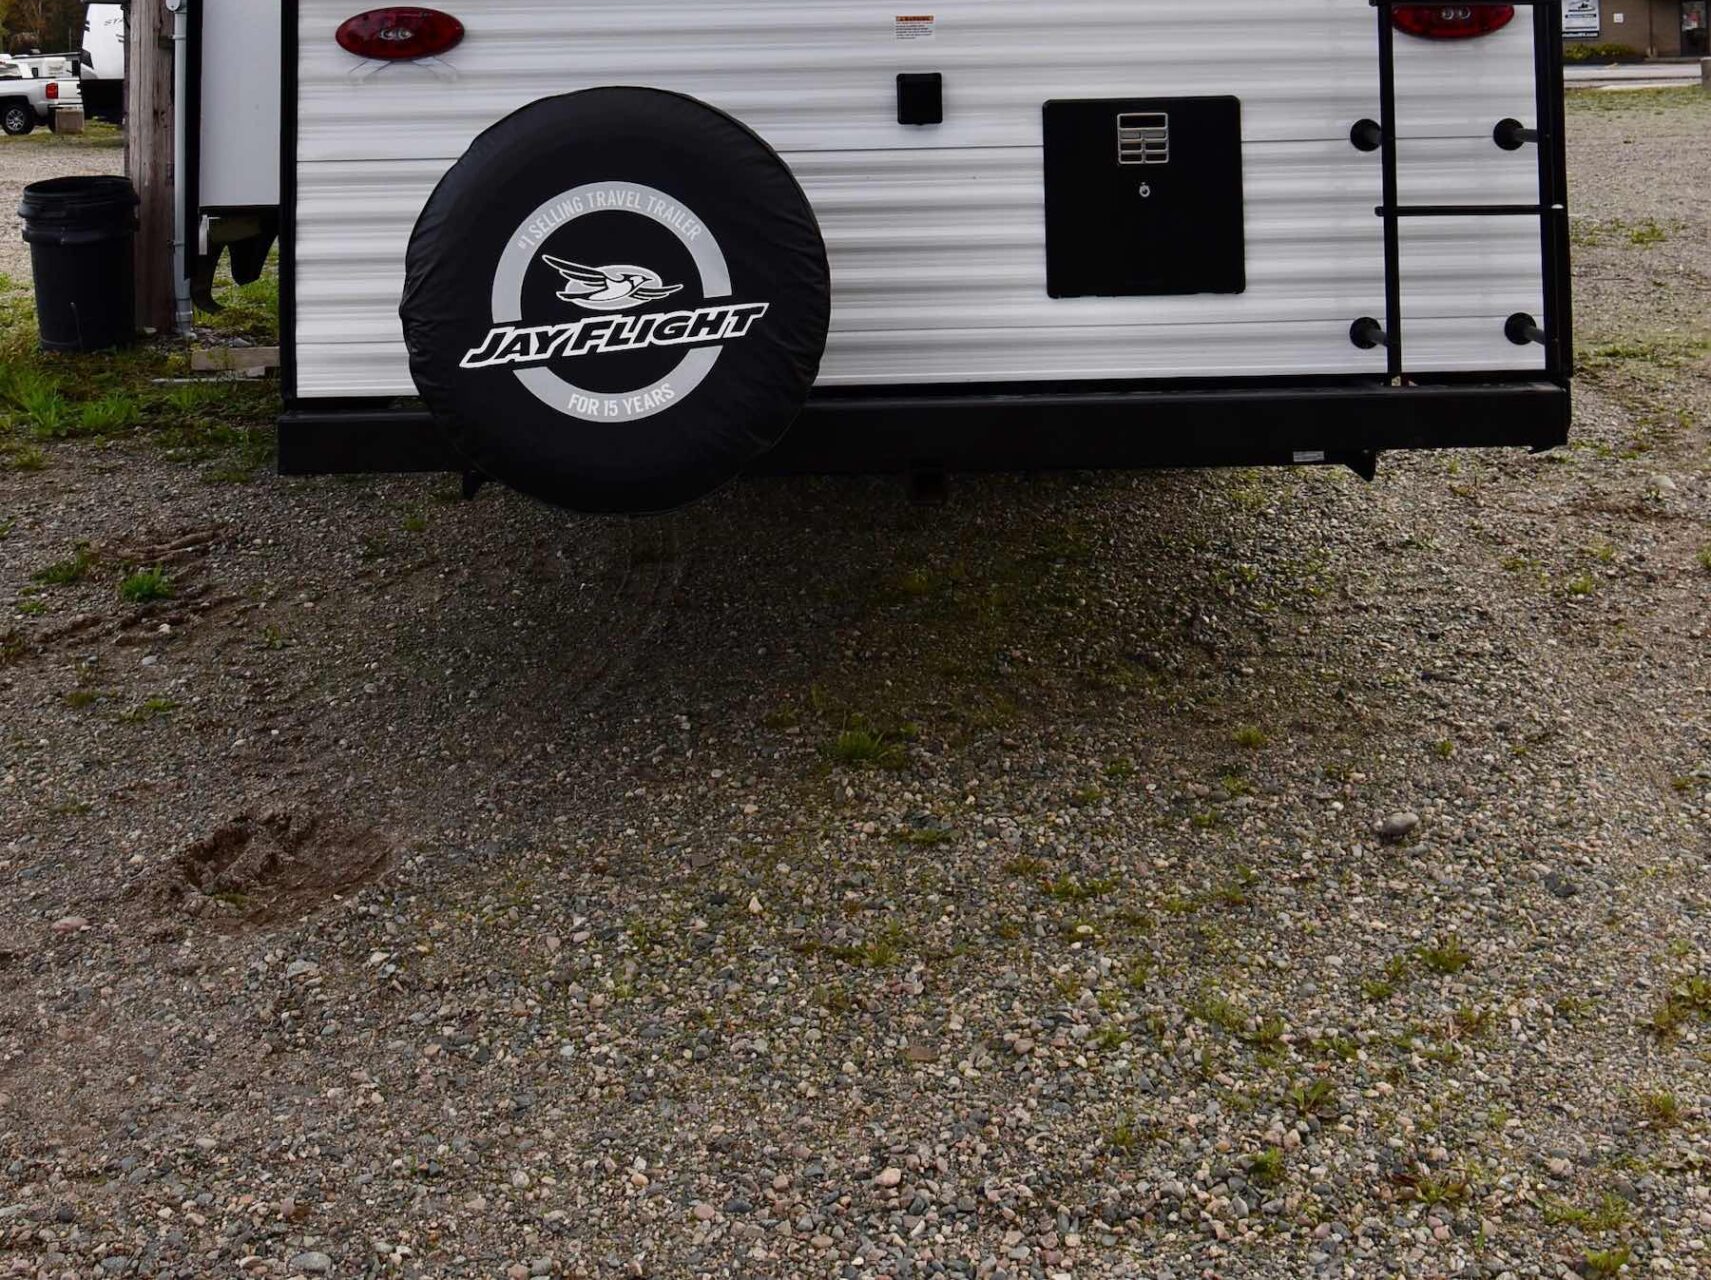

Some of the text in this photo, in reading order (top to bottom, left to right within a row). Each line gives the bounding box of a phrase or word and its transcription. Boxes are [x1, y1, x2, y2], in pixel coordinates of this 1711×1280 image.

[528, 196, 583, 239] SELLING
[586, 190, 641, 209] TRAVEL
[647, 195, 701, 241] TRAILER
[568, 383, 675, 417] FOR 15 YEARS
